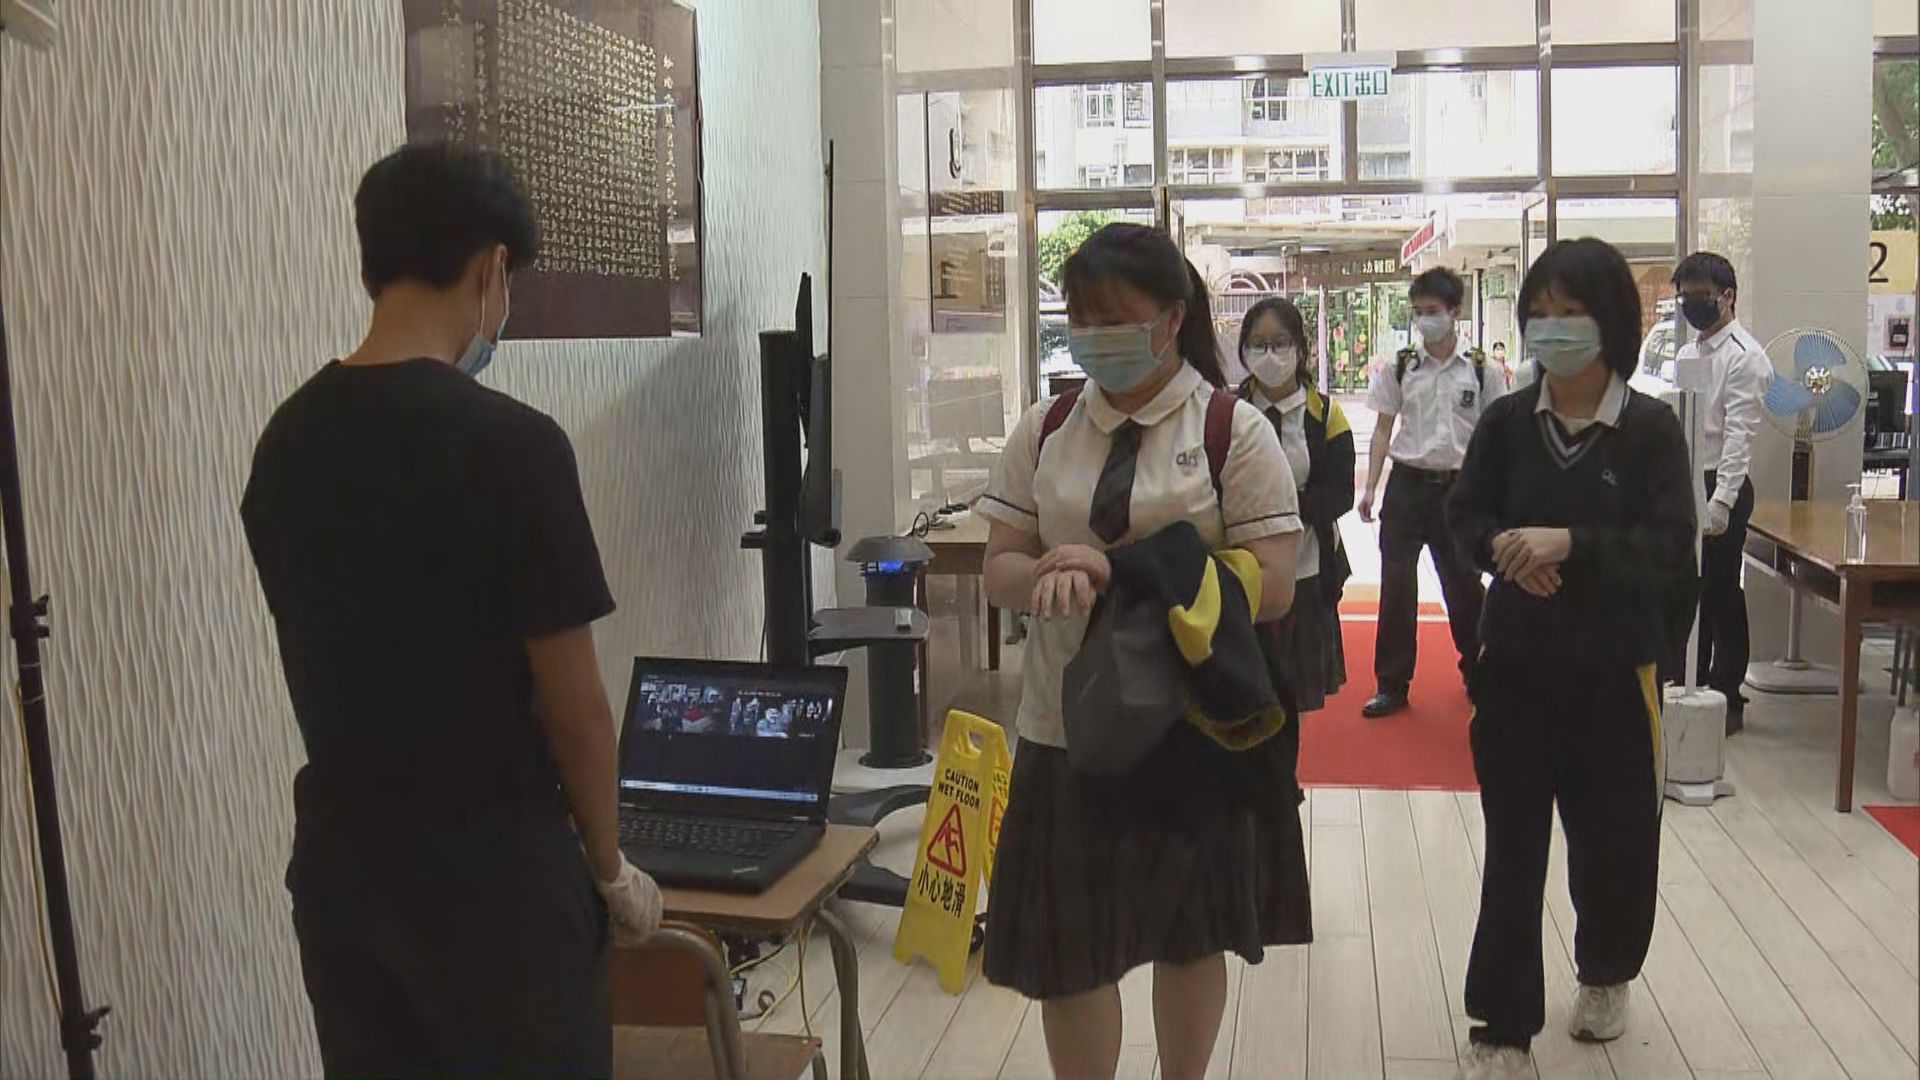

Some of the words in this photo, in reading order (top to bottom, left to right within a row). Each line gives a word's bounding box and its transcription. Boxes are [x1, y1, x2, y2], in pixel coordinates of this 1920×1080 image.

[1313, 72, 1351, 96] EXIT
[1355, 71, 1387, 95] 出口
[1869, 242, 1888, 283] 2
[945, 768, 979, 793] CAUTION
[938, 782, 954, 797] WET
[956, 789, 979, 811] FLOOR
[918, 862, 966, 919] 小心地滑
